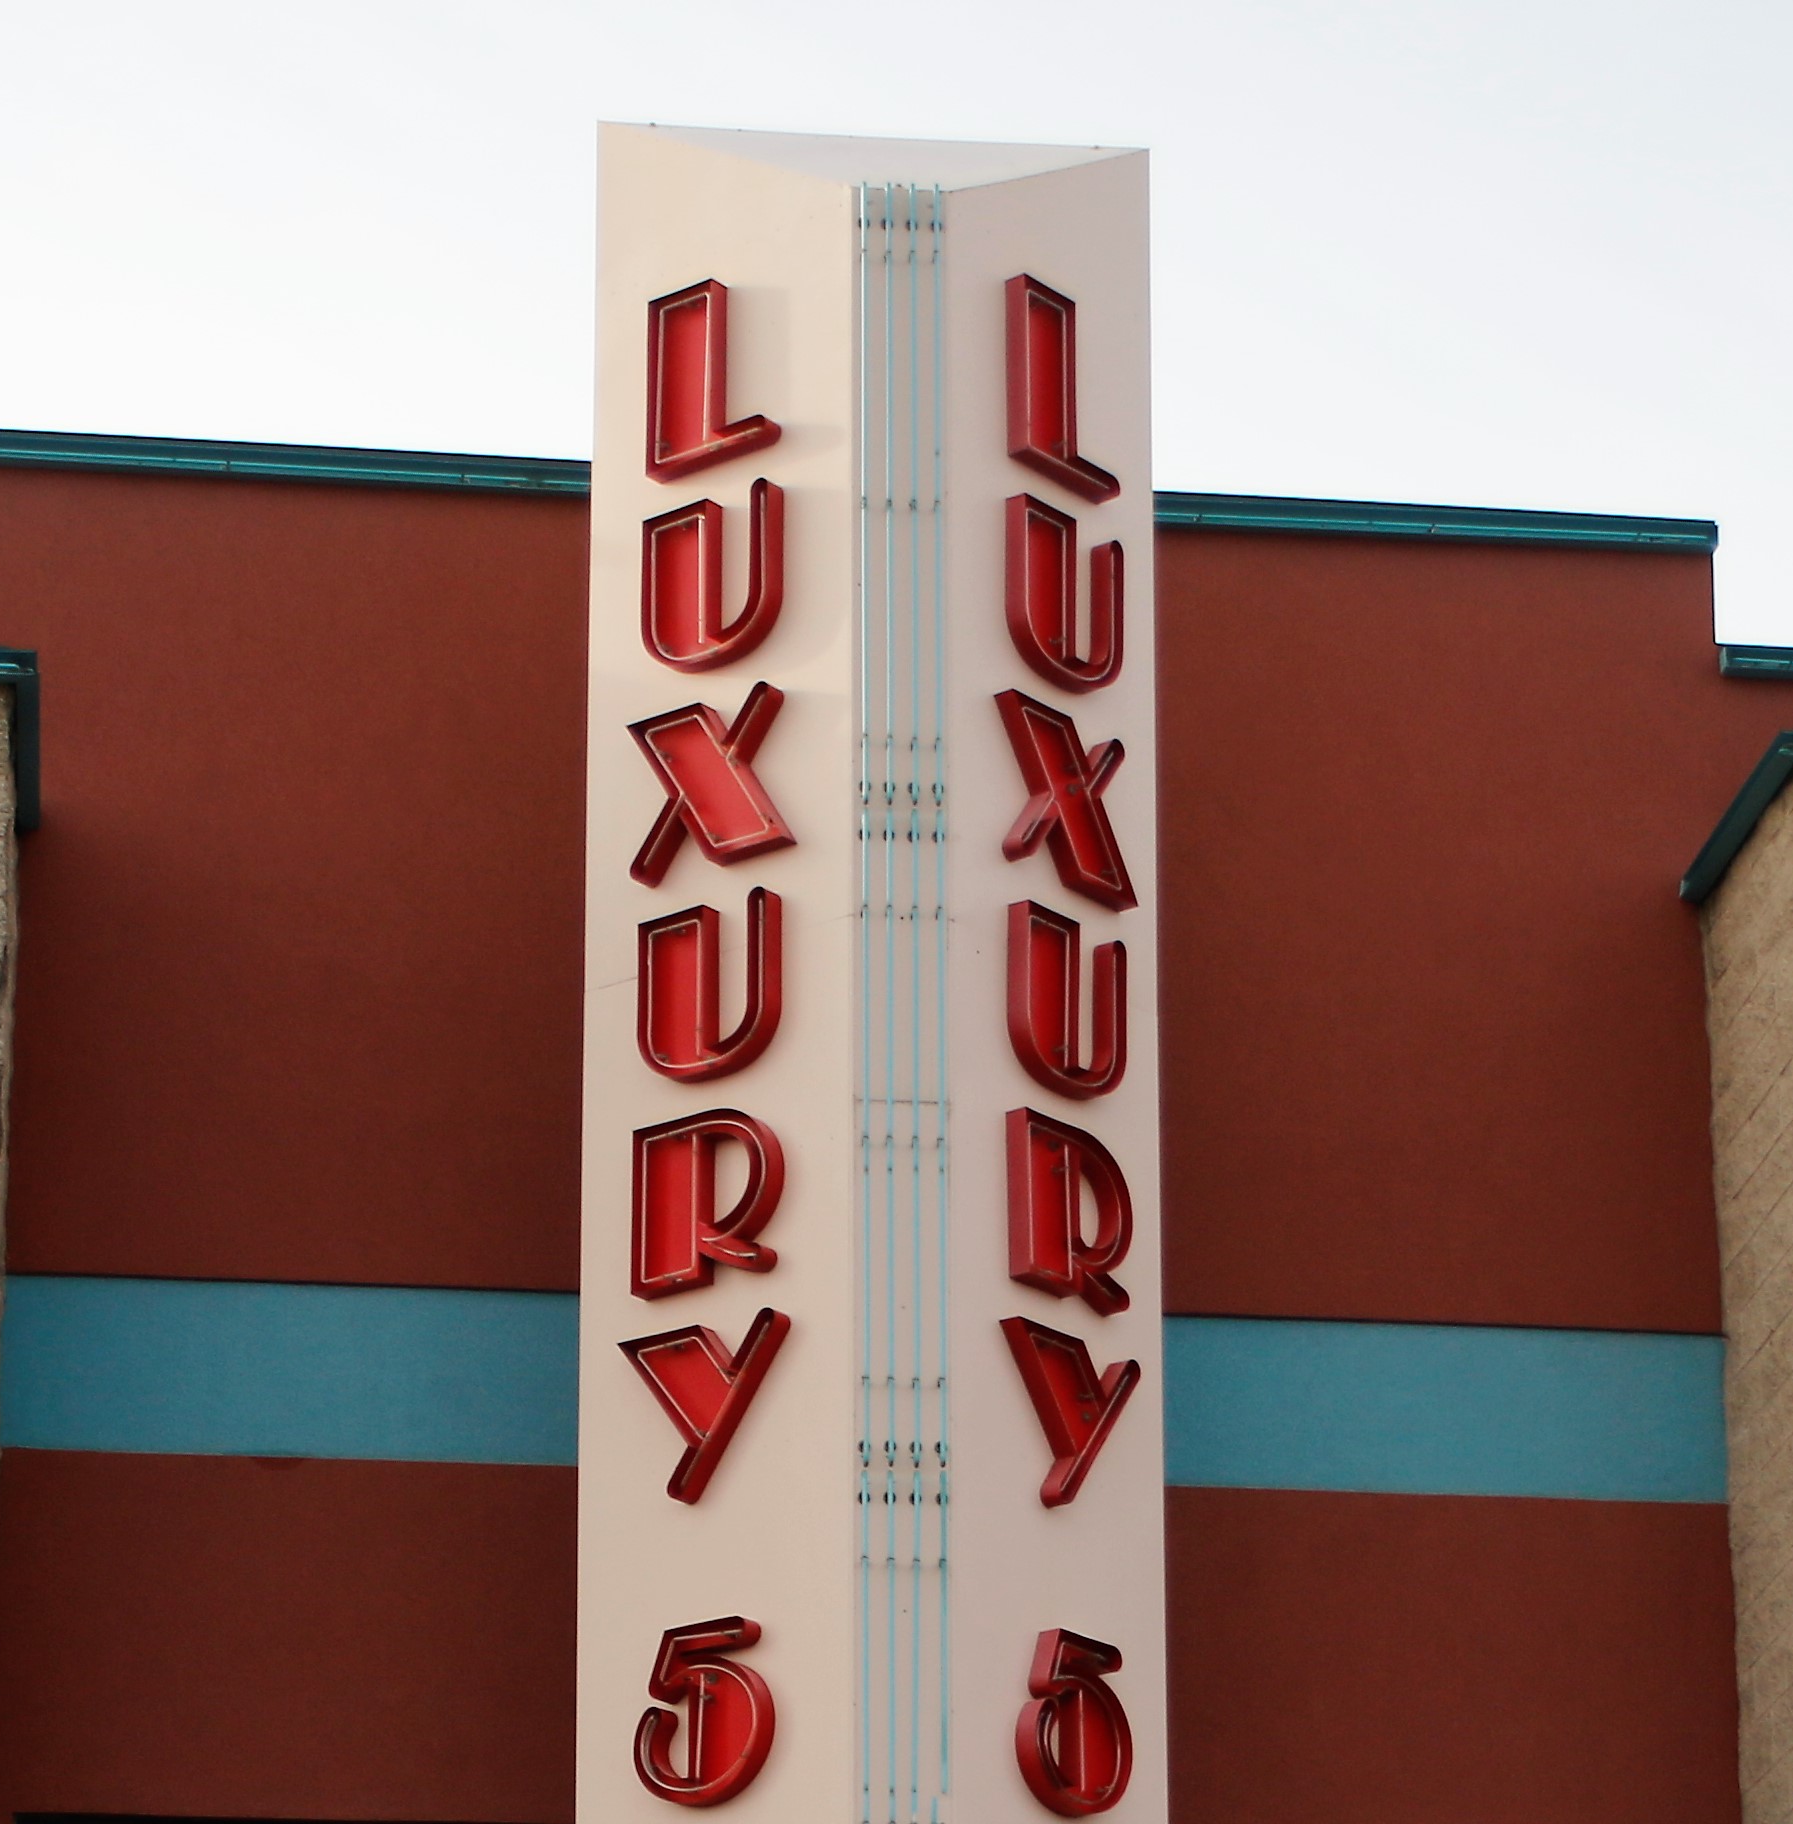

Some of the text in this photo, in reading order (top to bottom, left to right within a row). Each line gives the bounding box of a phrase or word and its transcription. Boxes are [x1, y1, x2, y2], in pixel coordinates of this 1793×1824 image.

[618, 278, 798, 1807] LUXURY 5
[994, 272, 1140, 1819] LUXURY 5
